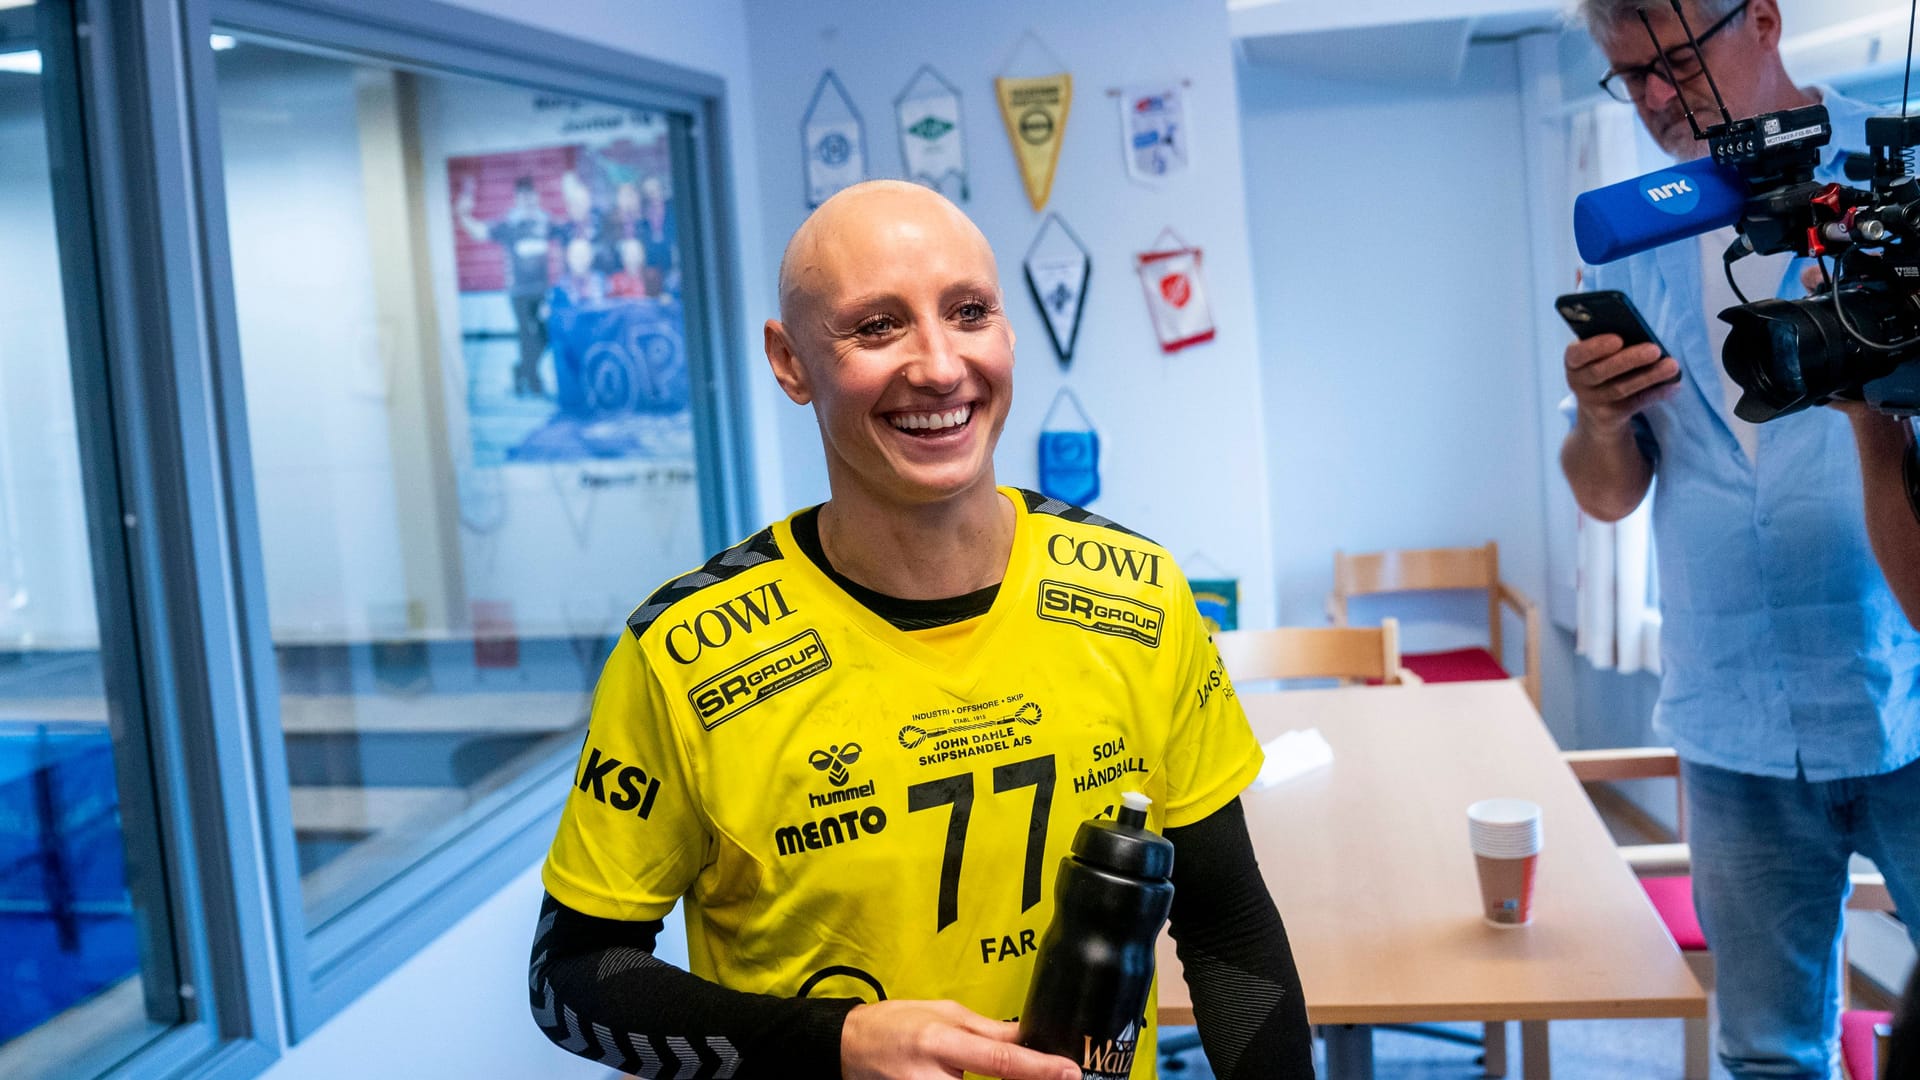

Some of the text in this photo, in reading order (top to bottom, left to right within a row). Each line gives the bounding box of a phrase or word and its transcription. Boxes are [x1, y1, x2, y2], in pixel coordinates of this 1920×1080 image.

[1048, 534, 1165, 588] COWI
[665, 579, 798, 665] COWI
[912, 693, 1024, 721] INDUSTRI OFFSHORE SKIP
[918, 735, 1033, 766] SKIPSHANDEL A/S
[933, 727, 1015, 751] JOHN DAHLE
[1093, 736, 1125, 762] SOLA
[574, 729, 661, 821] KSI
[1073, 757, 1149, 793] HÅNDBALL
[808, 779, 875, 808] hummel
[775, 806, 887, 856] MENTO
[908, 754, 1056, 933] 77
